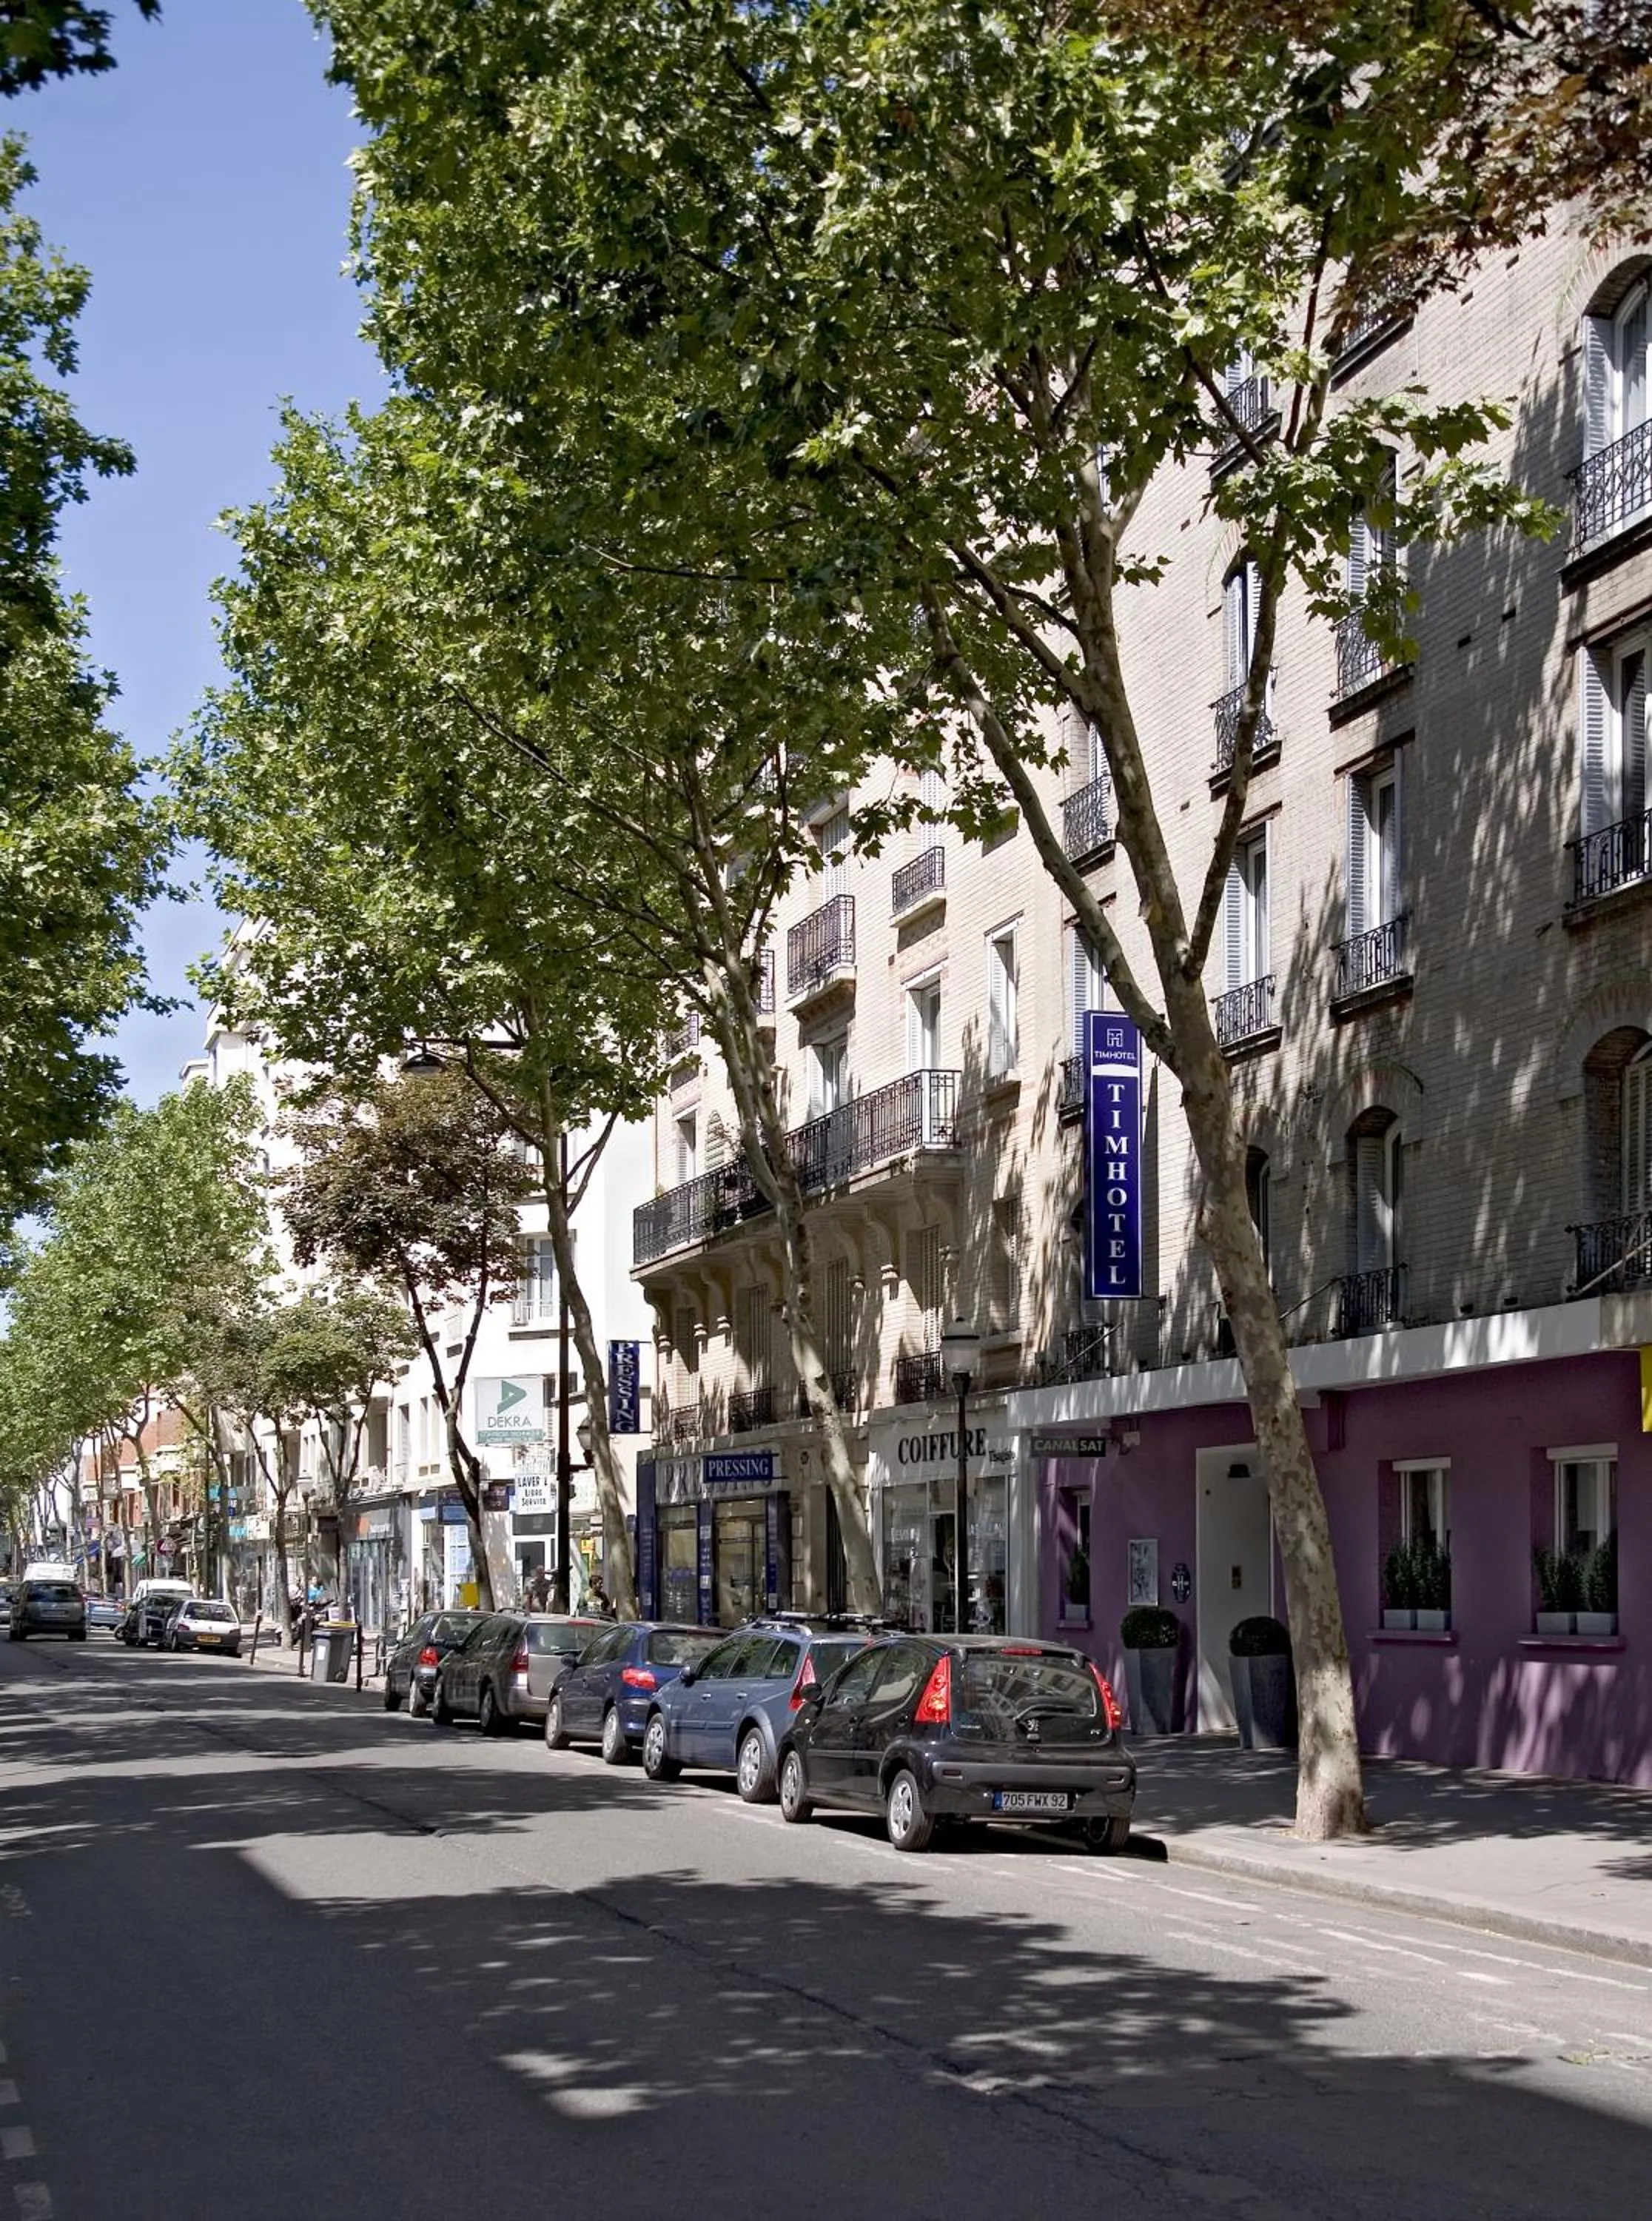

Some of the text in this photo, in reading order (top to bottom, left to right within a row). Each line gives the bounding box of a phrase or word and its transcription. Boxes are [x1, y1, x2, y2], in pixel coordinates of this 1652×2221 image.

[1104, 1082, 1129, 1285] TIMHOTEL
[615, 1341, 635, 1433] PRESSING
[488, 1416, 532, 1428] DEKRA
[898, 1427, 987, 1466] COIFFURE
[708, 1458, 769, 1478] PRESSING
[1003, 1793, 1025, 1806] 705
[1051, 1793, 1066, 1807] 92
